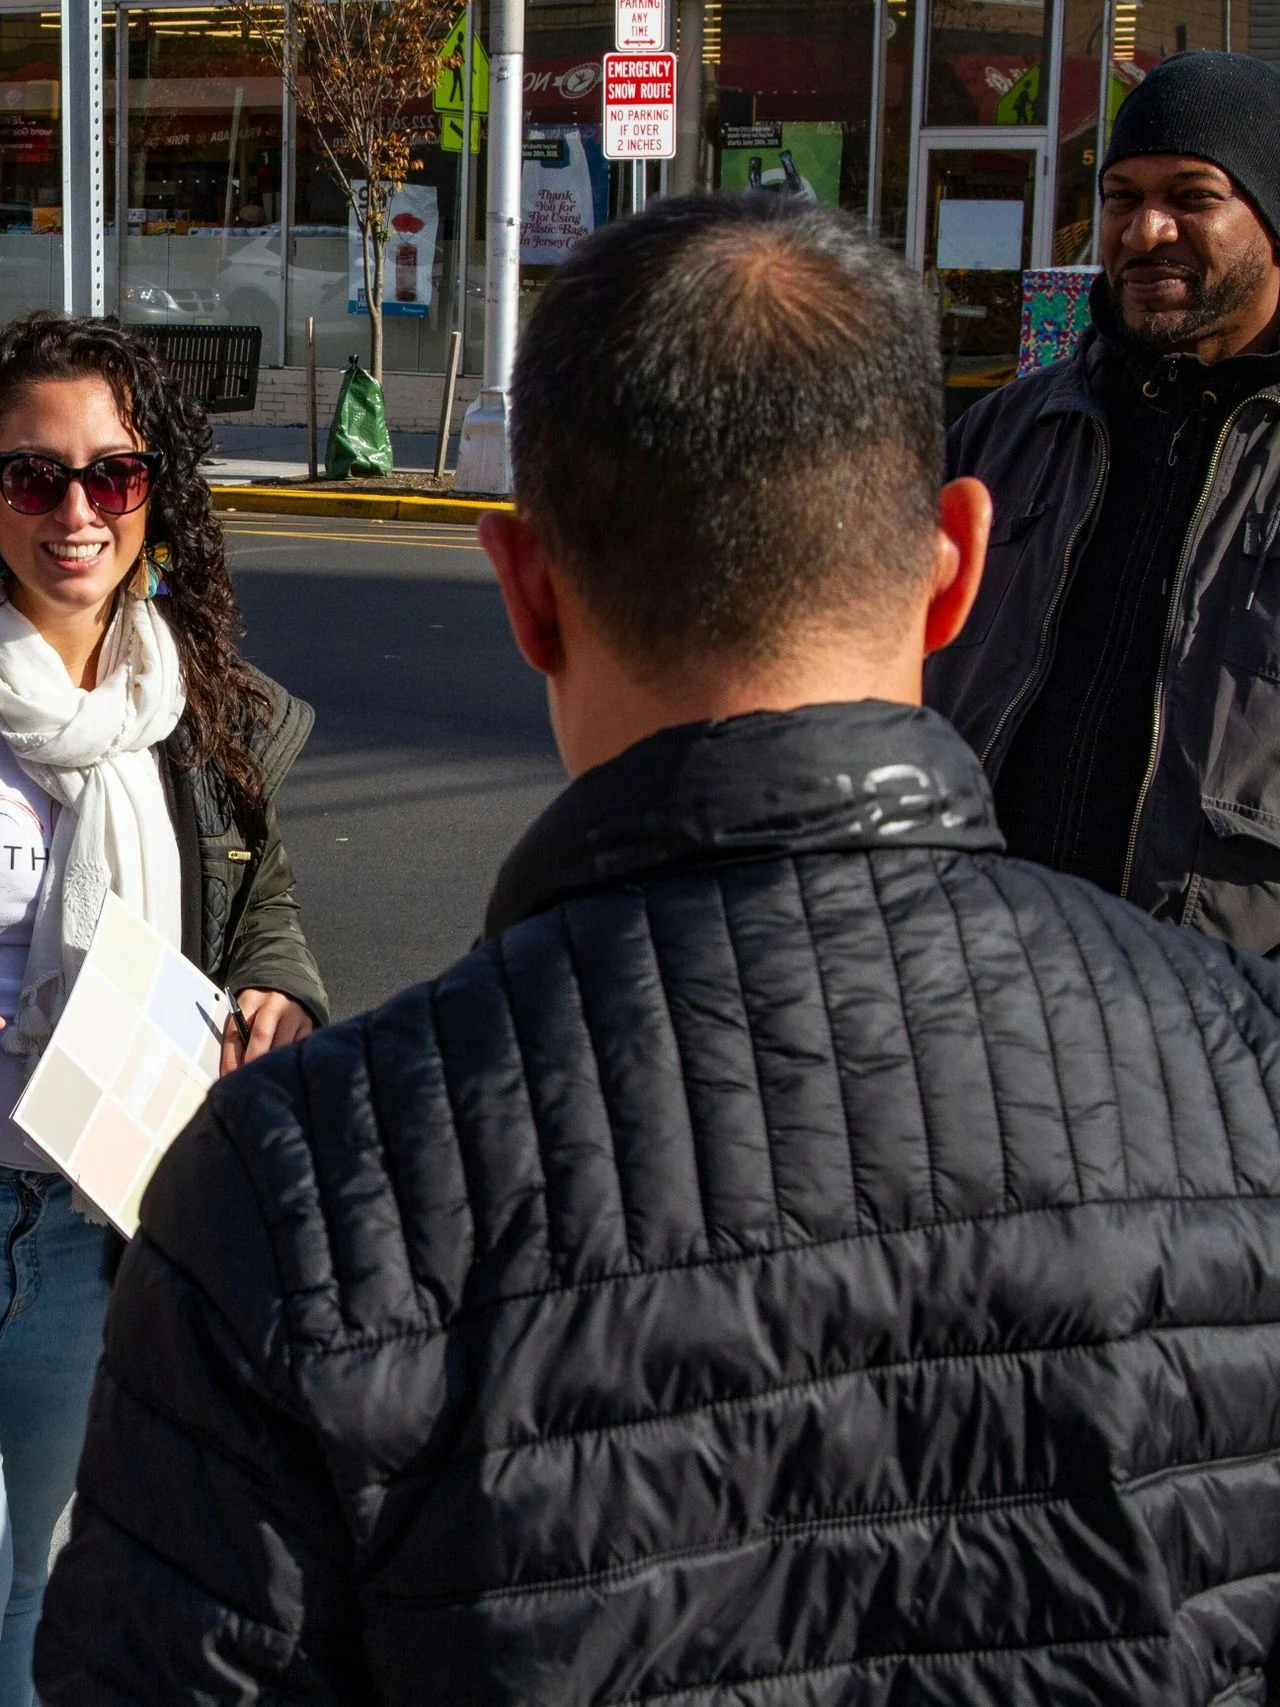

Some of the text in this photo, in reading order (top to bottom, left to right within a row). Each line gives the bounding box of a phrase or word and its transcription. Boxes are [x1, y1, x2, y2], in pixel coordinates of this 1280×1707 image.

[619, 0, 660, 9] PARKING
[631, 13, 649, 23] ANY
[631, 26, 649, 37] TIME
[608, 61, 671, 78] EMERGENCY
[608, 83, 672, 99] SNOW ROUTE
[610, 110, 669, 121] NO PARKING
[620, 124, 659, 136] IF OVER
[617, 139, 662, 151] 2 INCHES
[1082, 149, 1094, 166] 5
[537, 189, 577, 203] Thank
[535, 201, 576, 215] You for
[528, 211, 581, 225] Not Using
[521, 222, 589, 238] Plastic Bags
[531, 235, 566, 248] Jersey
